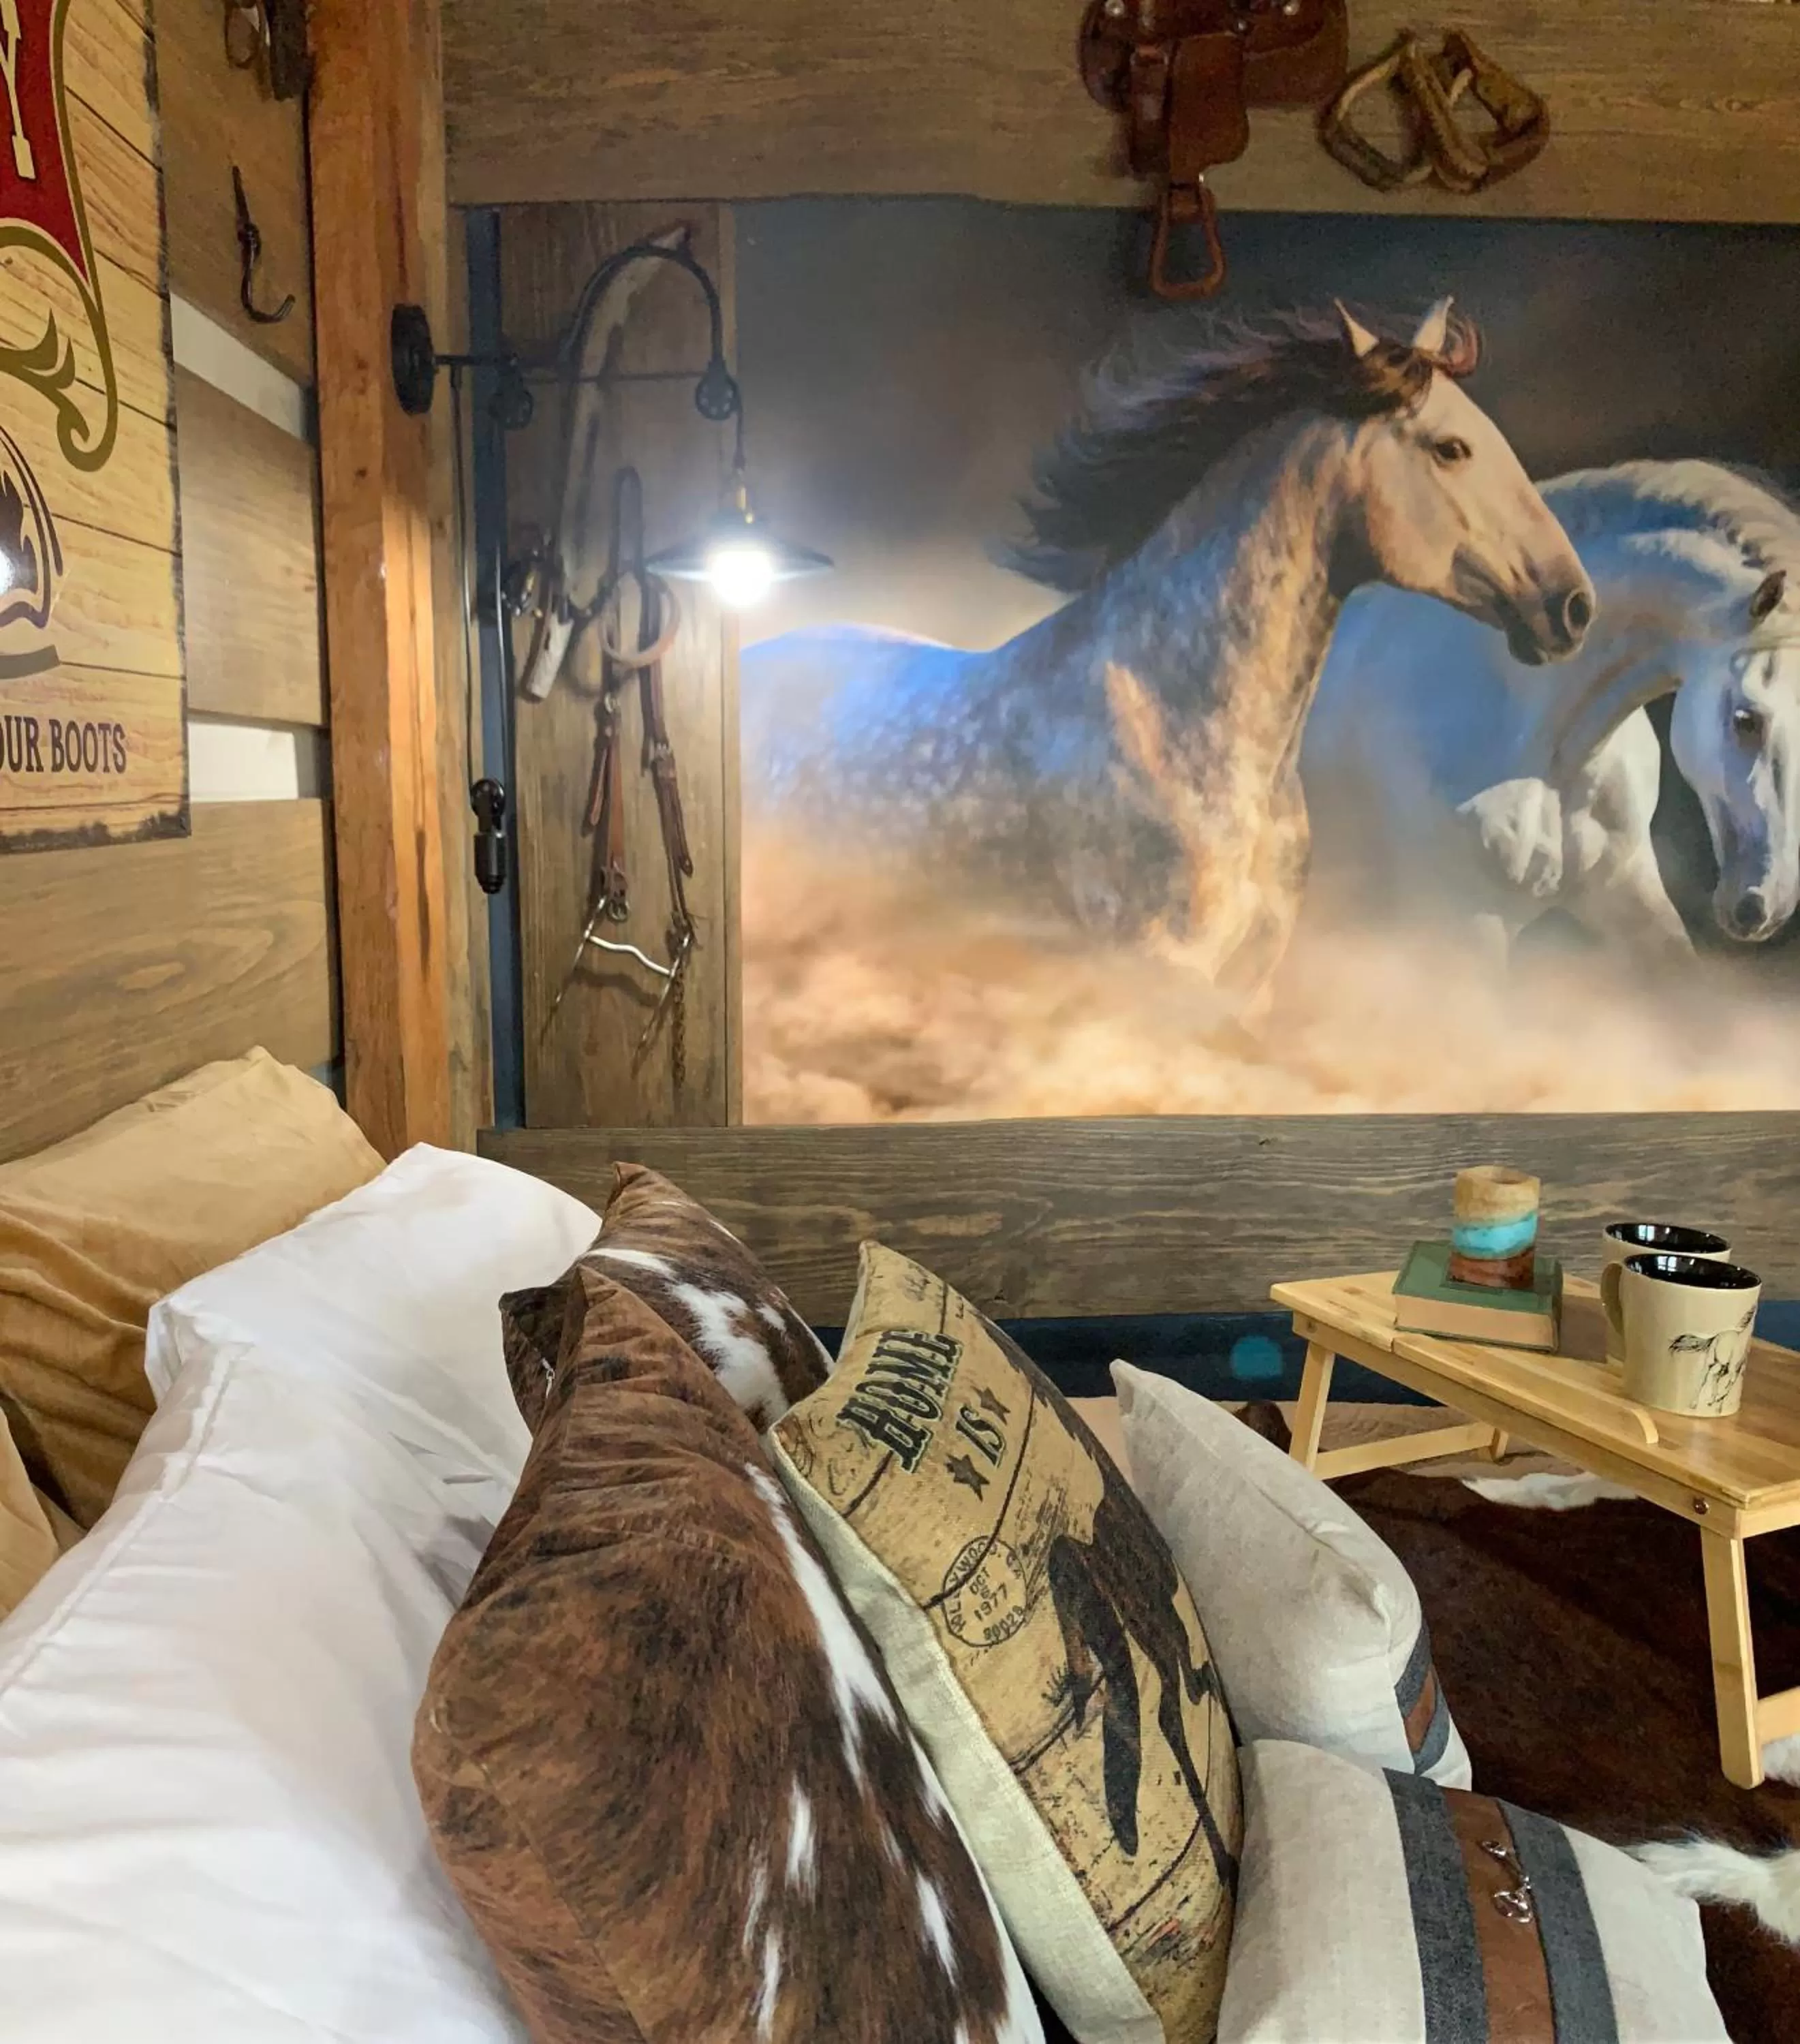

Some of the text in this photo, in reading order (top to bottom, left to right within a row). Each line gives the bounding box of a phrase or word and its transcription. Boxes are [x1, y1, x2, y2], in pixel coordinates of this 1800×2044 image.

[0, 715, 127, 773] UR BOOTS
[835, 1330, 963, 1474] HOME
[955, 1402, 1006, 1468] IS
[969, 1566, 990, 1595] OCT
[973, 1581, 1008, 1622] 1977
